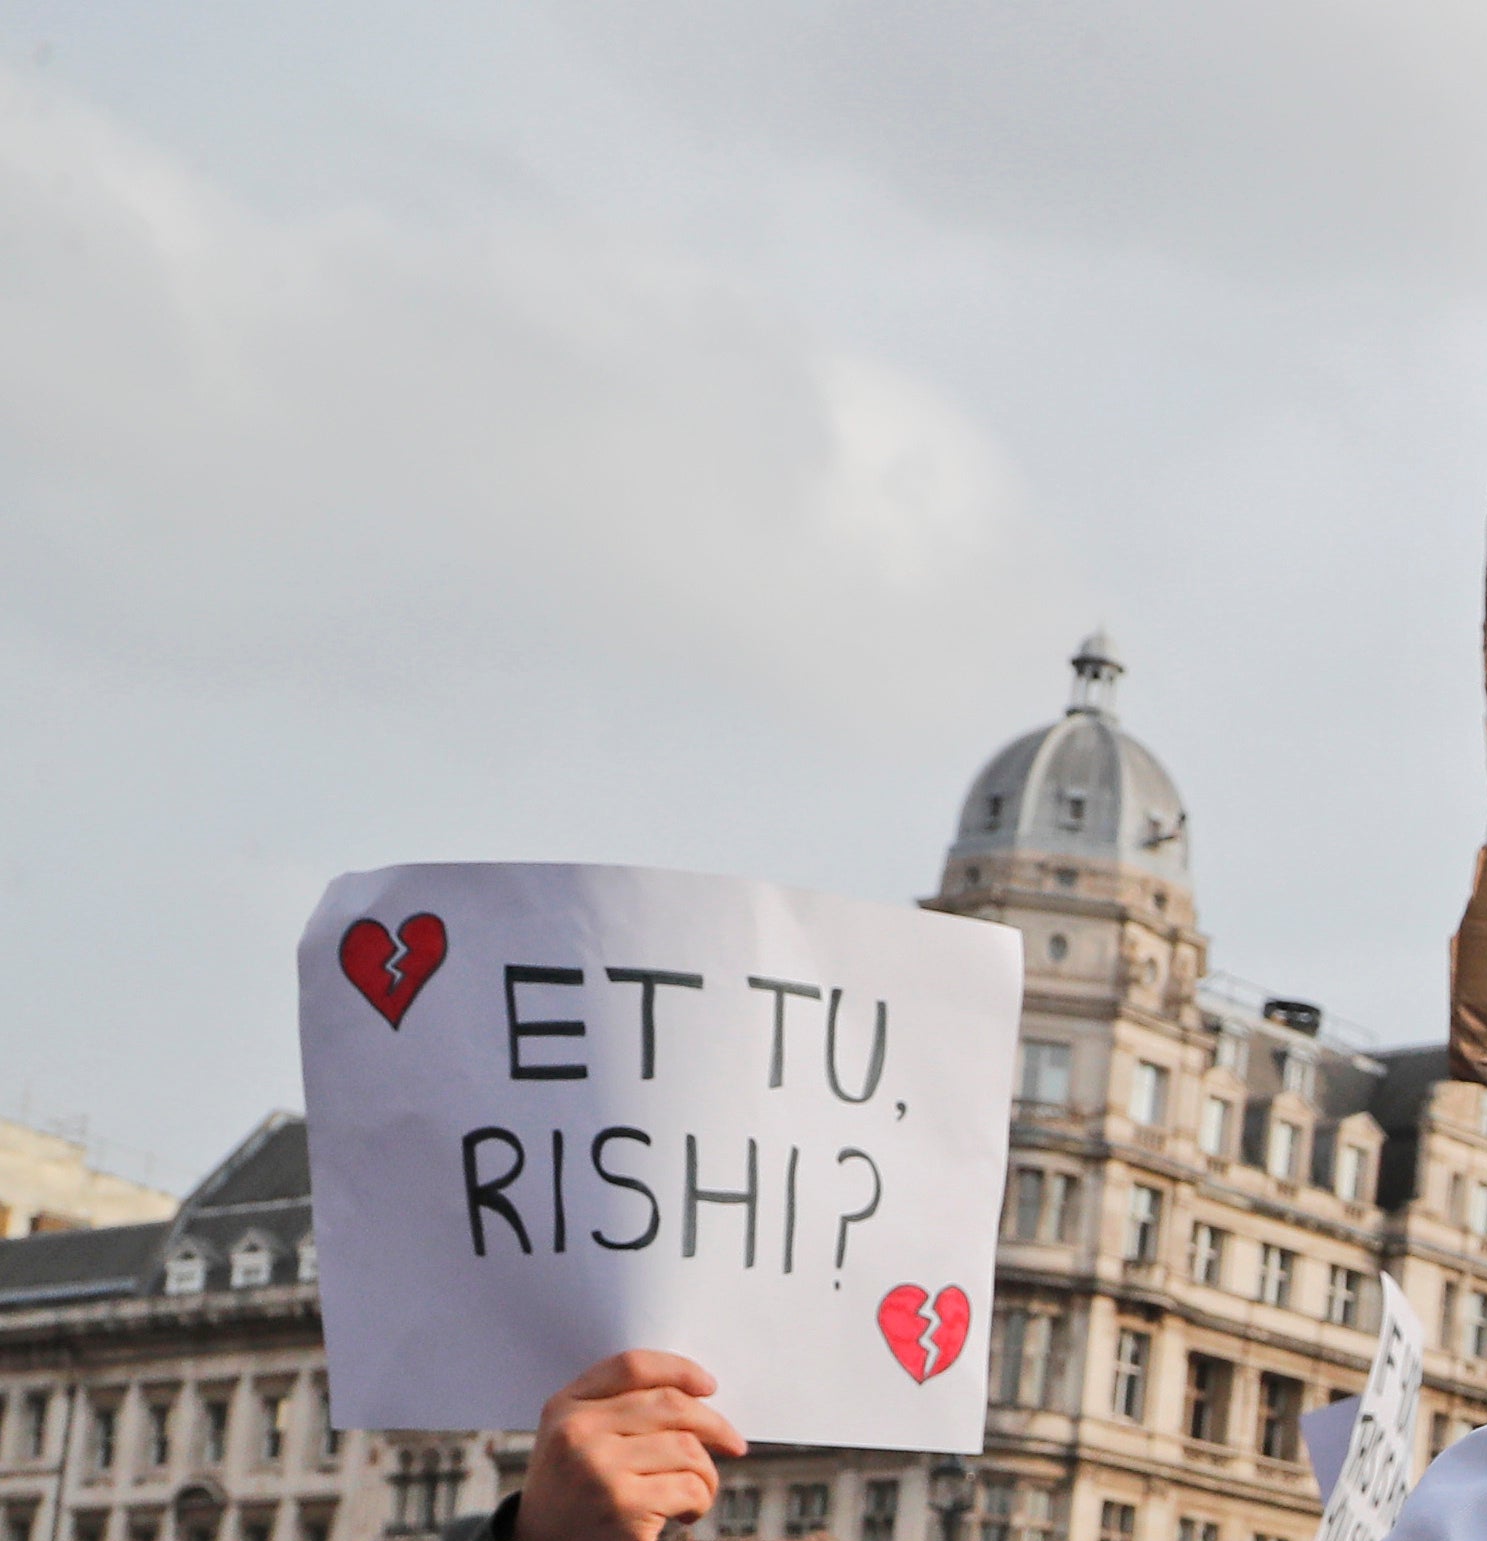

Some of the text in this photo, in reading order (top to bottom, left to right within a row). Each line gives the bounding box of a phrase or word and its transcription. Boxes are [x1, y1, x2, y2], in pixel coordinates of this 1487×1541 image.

[503, 963, 908, 1122] ET TU,
[461, 1125, 883, 1291] RISHI?
